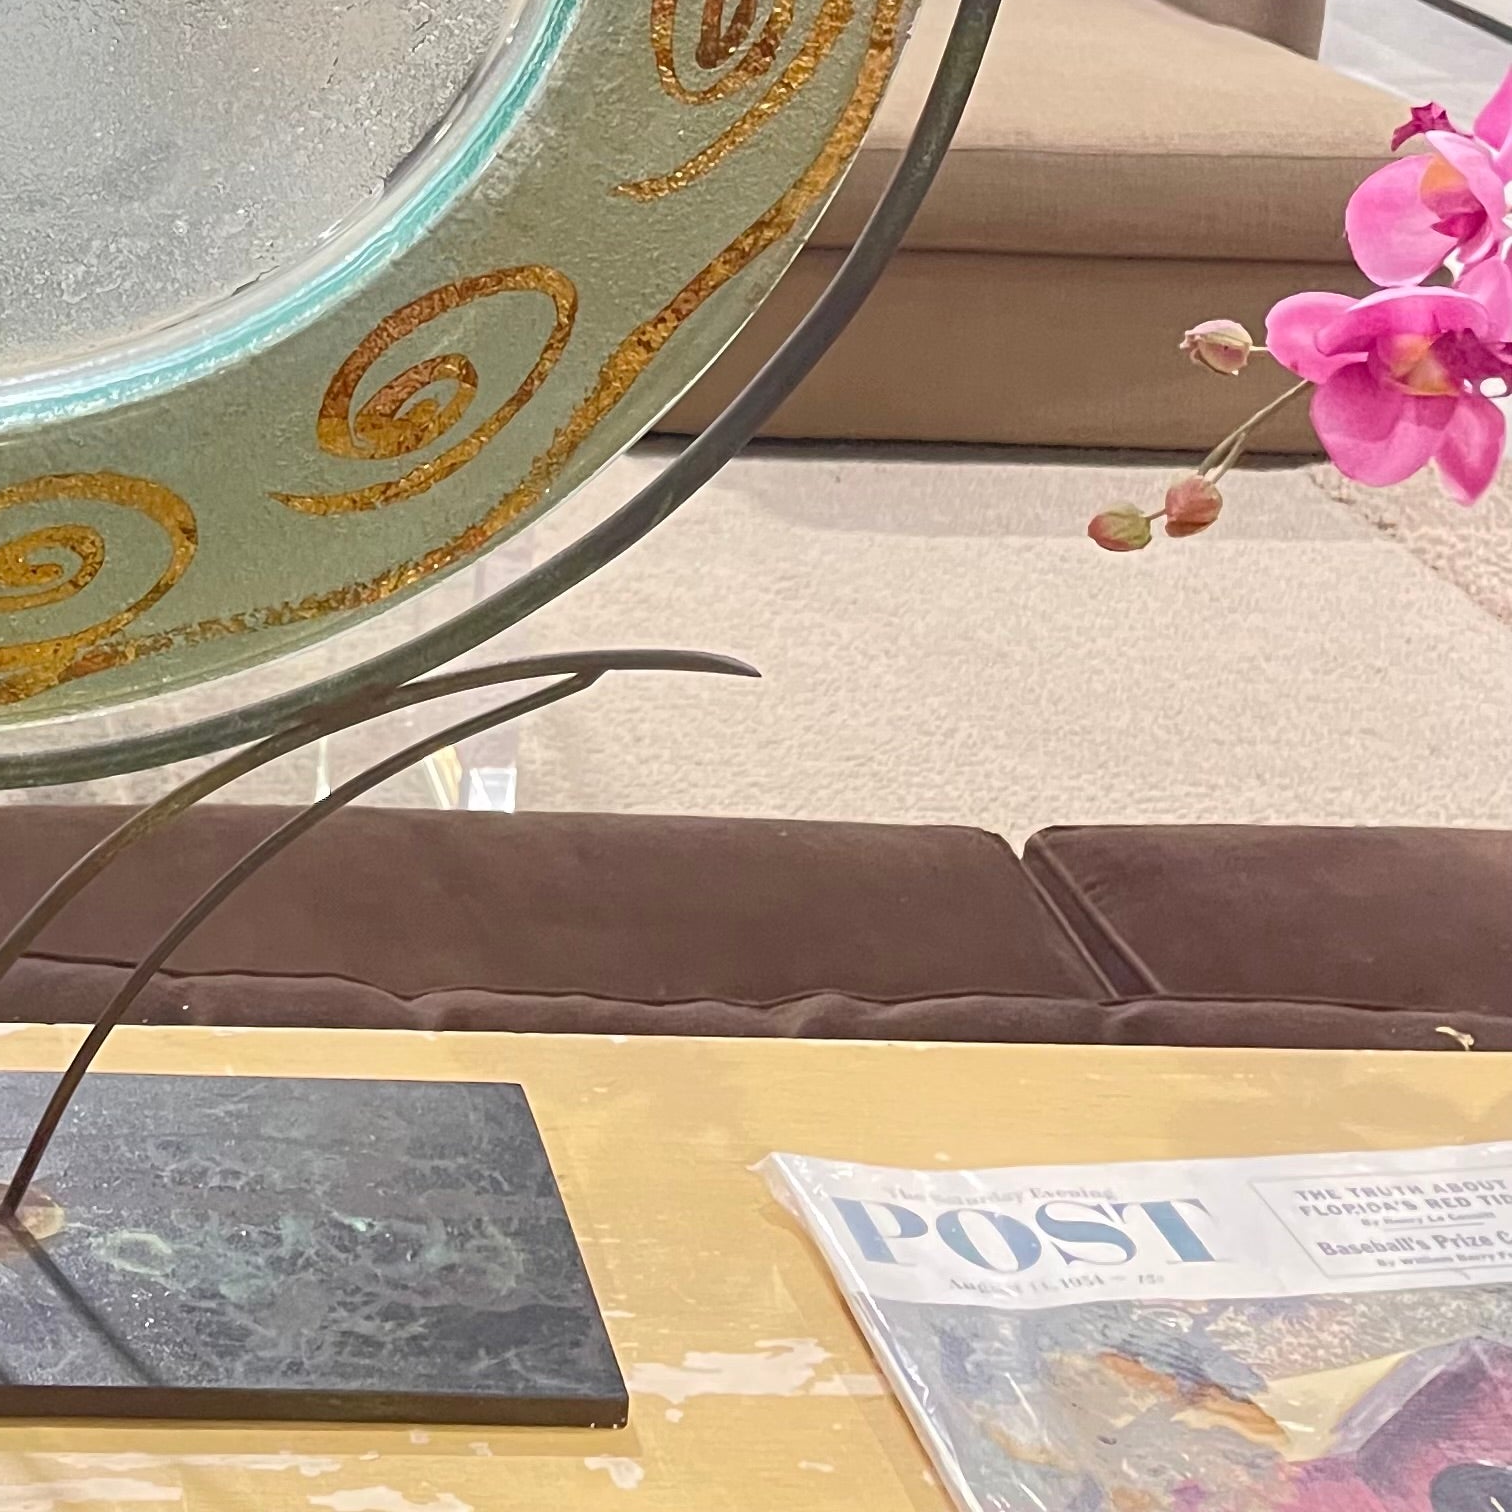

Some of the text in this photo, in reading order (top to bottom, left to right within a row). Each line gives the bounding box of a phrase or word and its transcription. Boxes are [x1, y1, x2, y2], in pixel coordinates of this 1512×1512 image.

[1294, 1179, 1507, 1203] THE TRUTH ABOUT
[1425, 1194, 1472, 1210] RED
[832, 1196, 1221, 1273] POST
[1317, 1236, 1431, 1256] Baseball's
[1431, 1232, 1494, 1250] Prize
